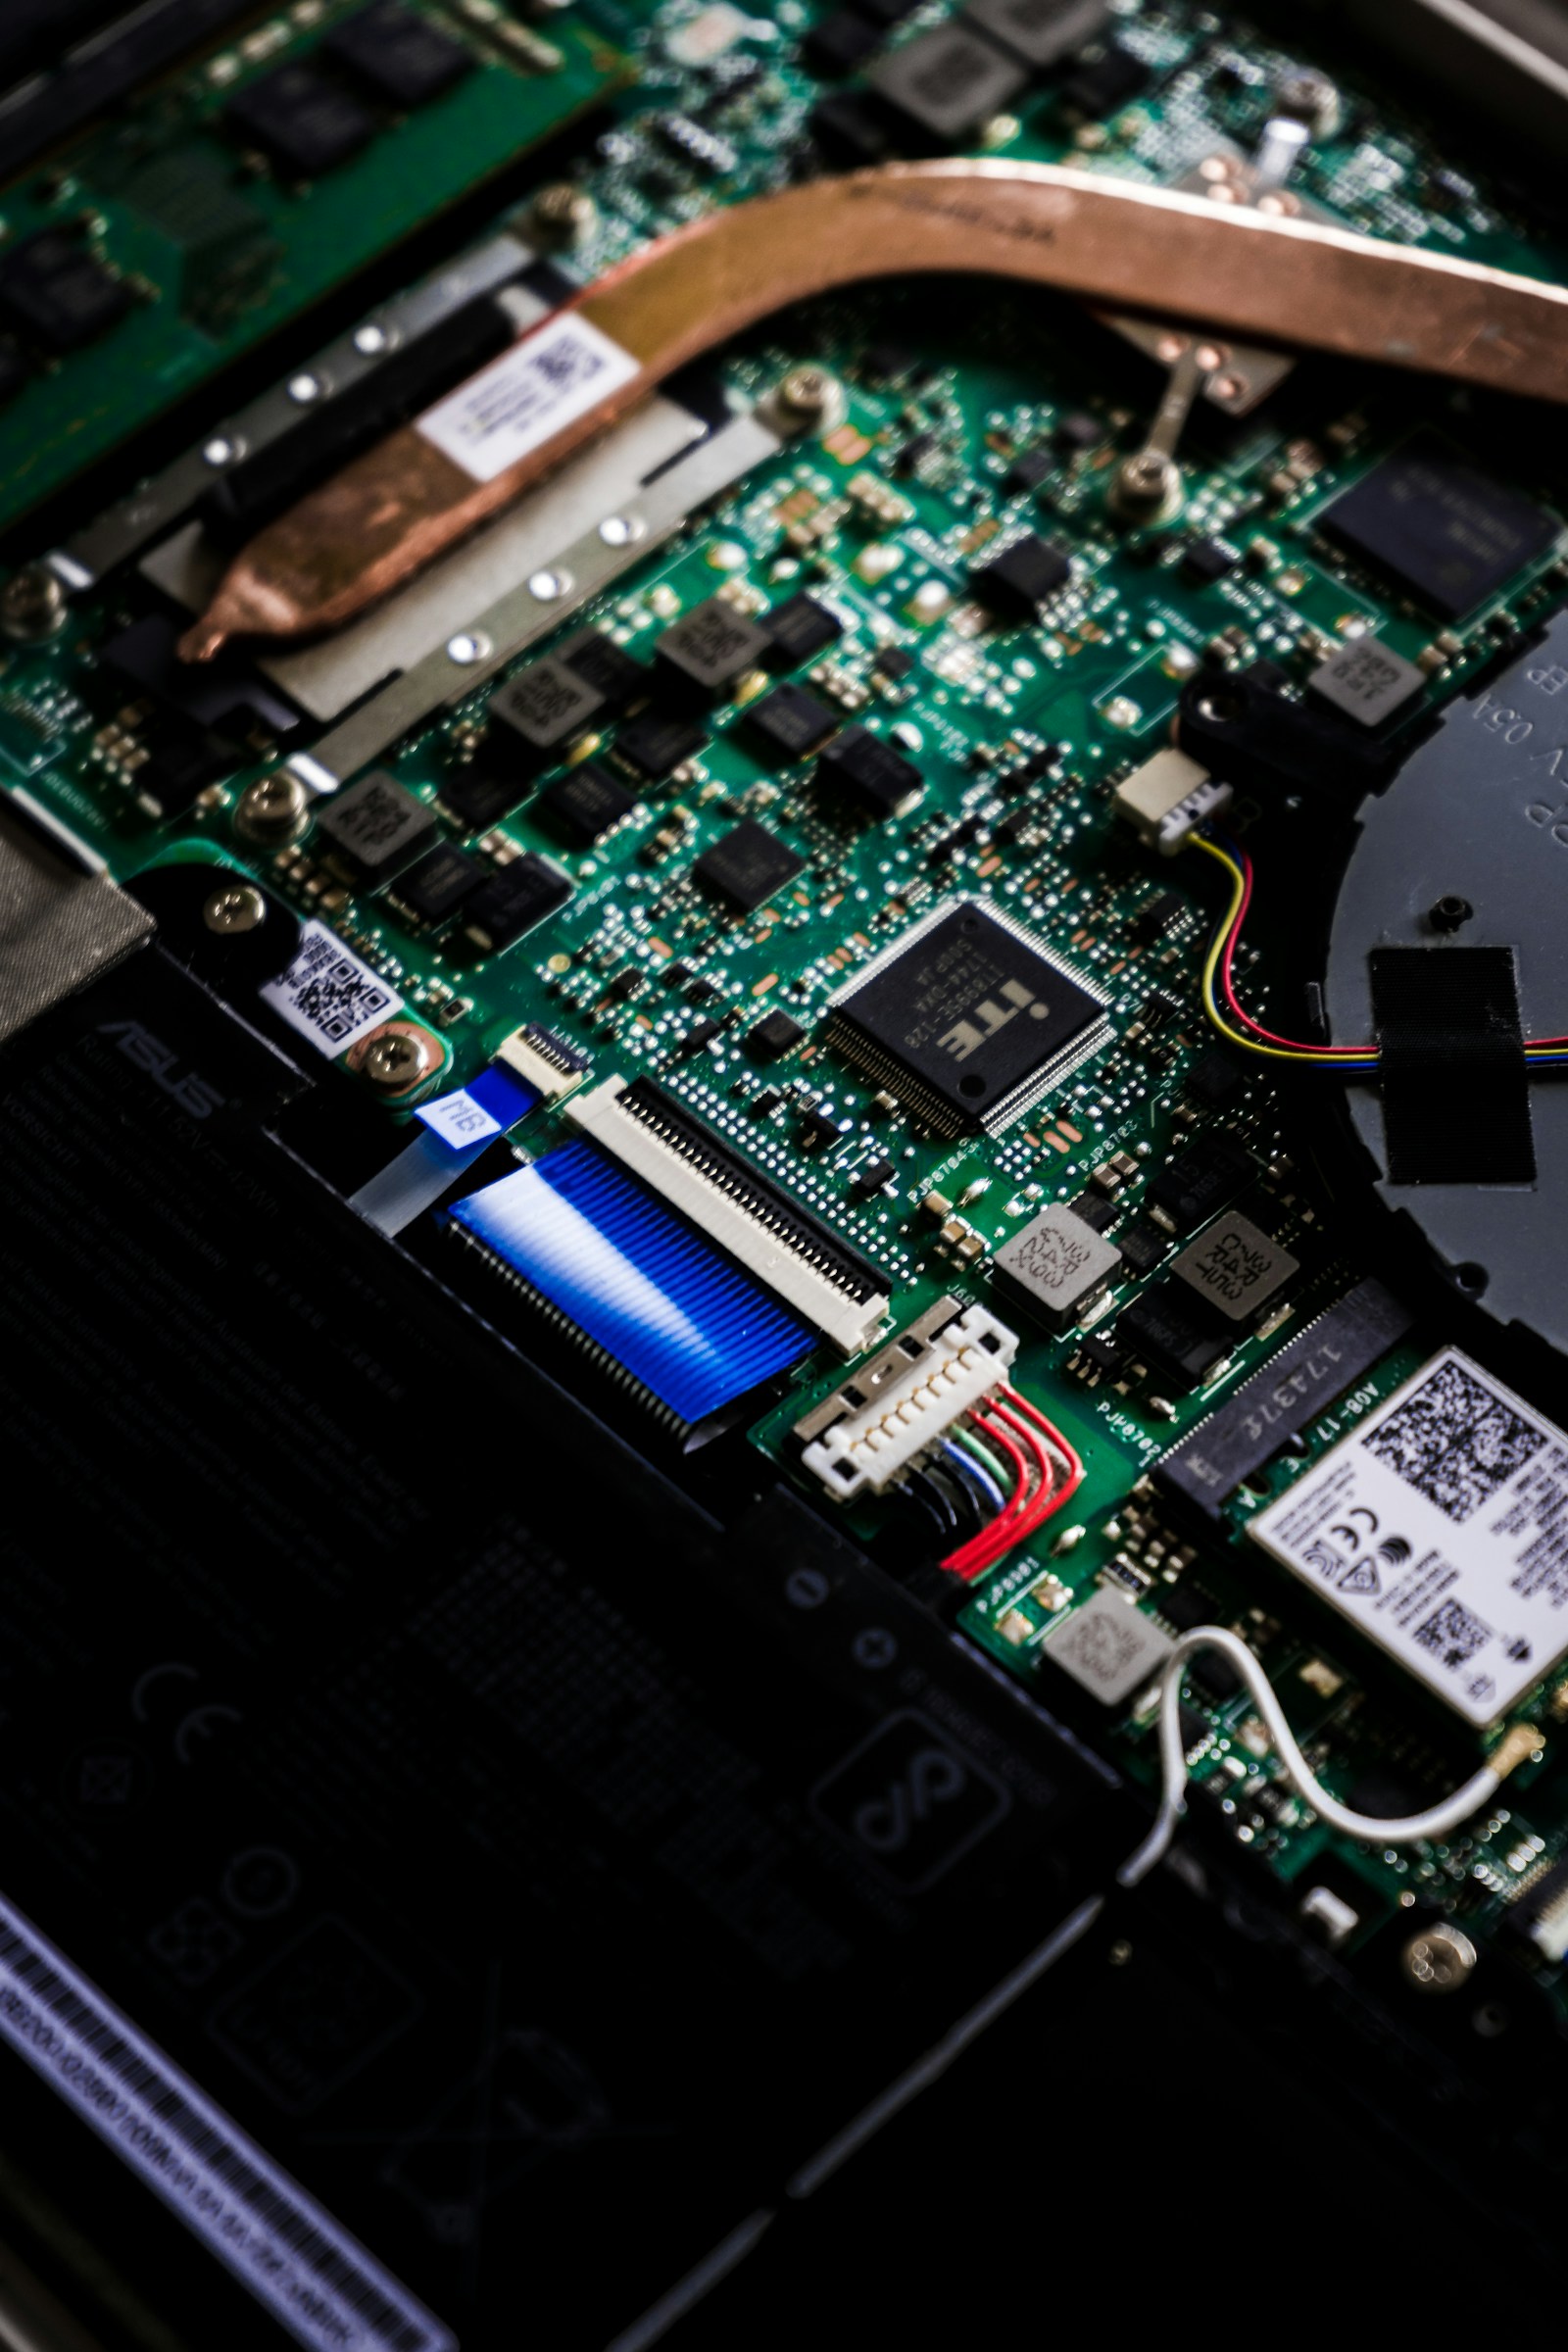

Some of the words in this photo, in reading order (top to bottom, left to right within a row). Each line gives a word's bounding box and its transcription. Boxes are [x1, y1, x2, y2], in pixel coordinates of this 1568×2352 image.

[94, 1019, 227, 1119] ASUS
[1194, 1232, 1240, 1278] CRT
[1207, 1243, 1254, 1290] 745
[1222, 1253, 1270, 1301] 3R3
